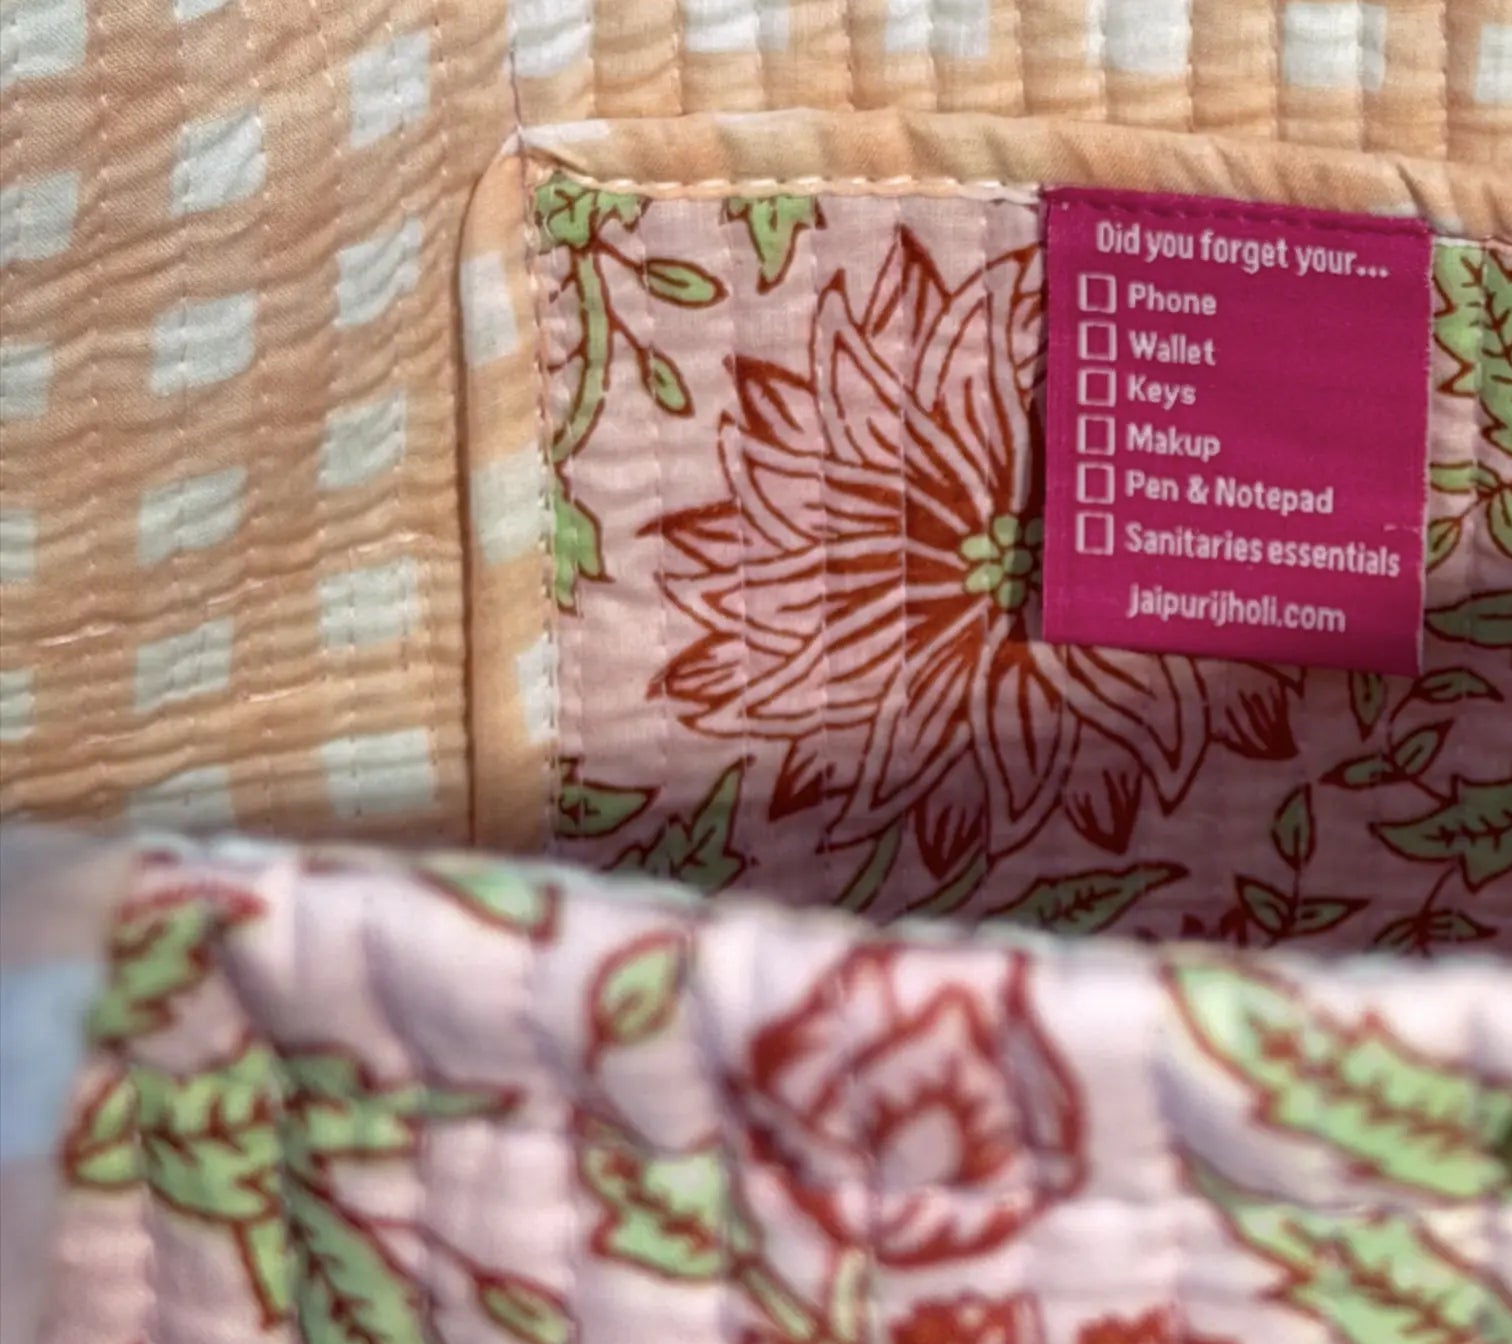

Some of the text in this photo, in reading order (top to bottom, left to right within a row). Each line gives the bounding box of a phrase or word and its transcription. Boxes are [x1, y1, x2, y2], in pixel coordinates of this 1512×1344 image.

[1097, 221, 1389, 279] Did you forget your...
[1127, 281, 1216, 316] Phone
[1128, 329, 1216, 366] Wallet
[1127, 374, 1196, 410] Keys
[1126, 422, 1221, 462] Makup
[1125, 470, 1334, 517] Pen & Notepad
[1125, 522, 1400, 578] Sanitaries essentials
